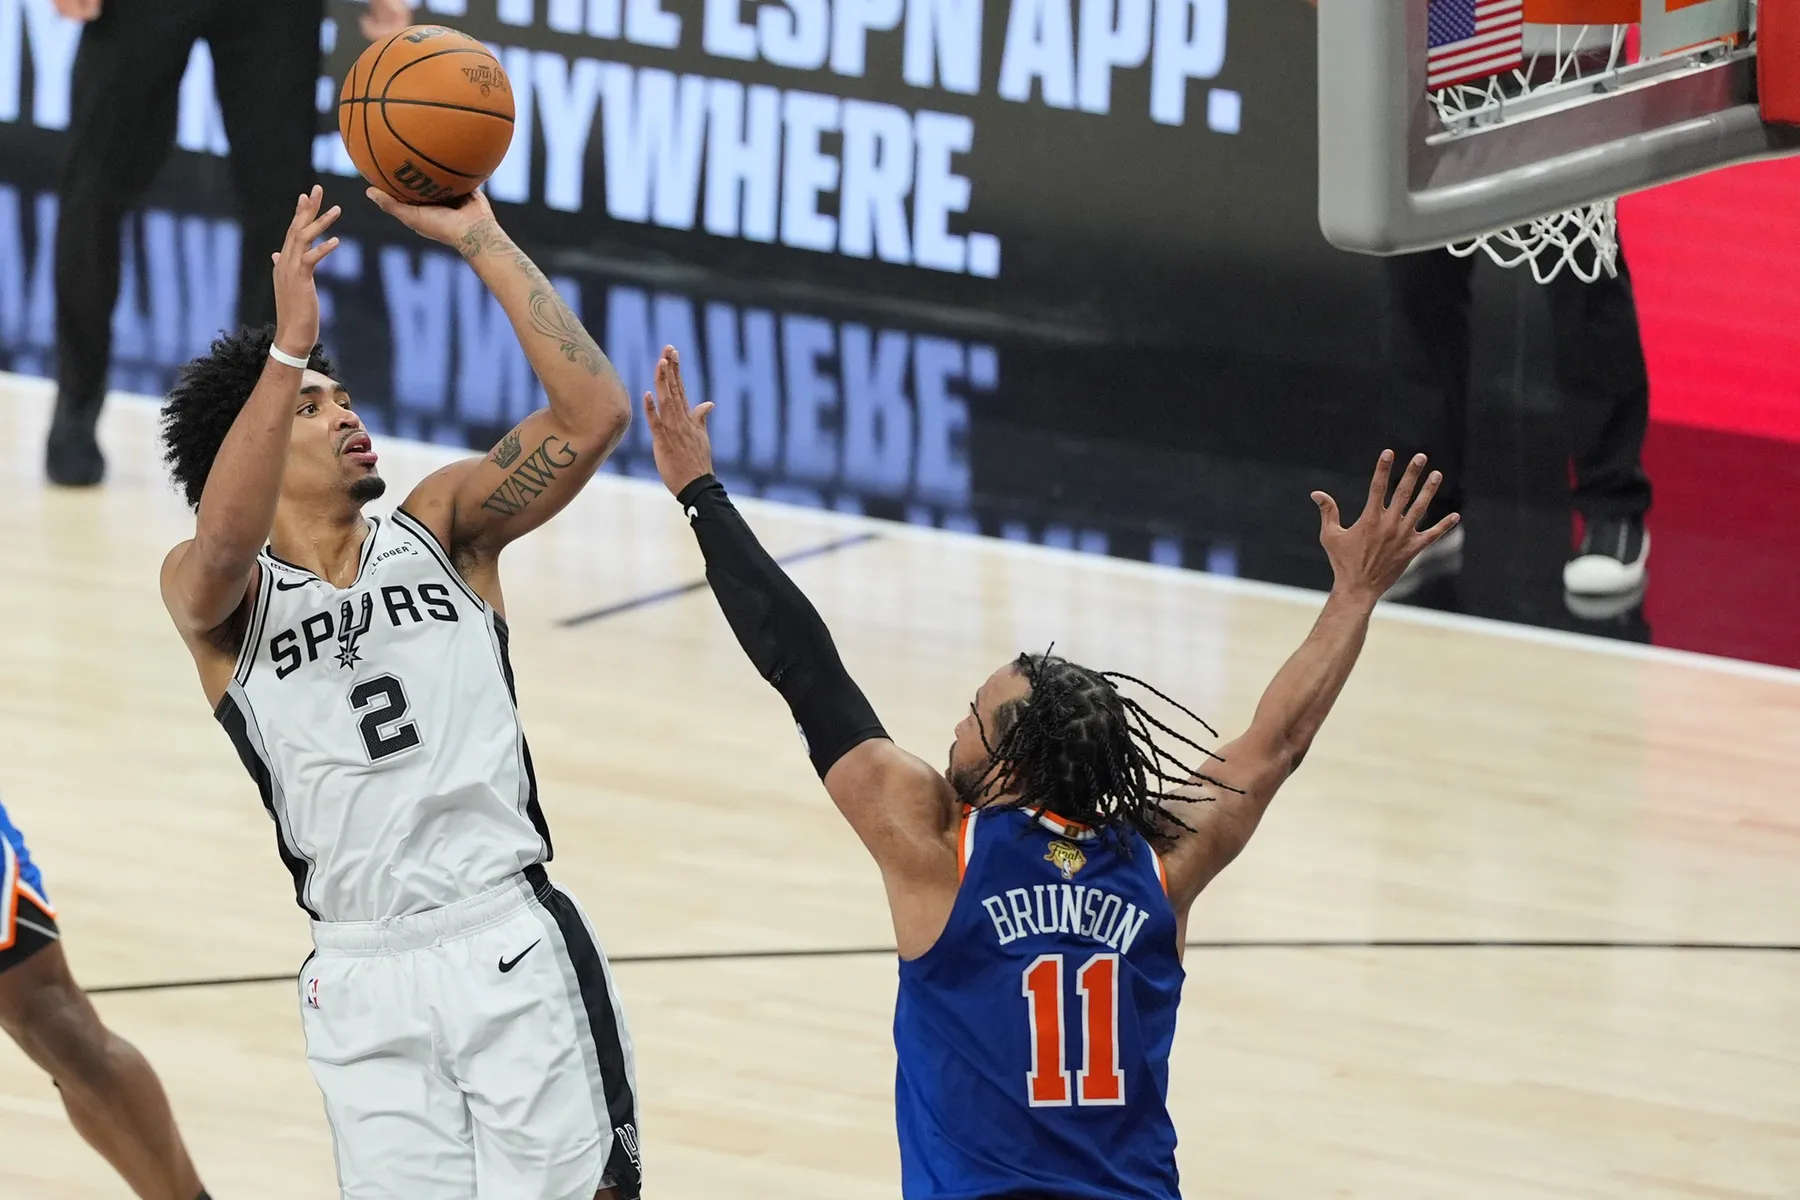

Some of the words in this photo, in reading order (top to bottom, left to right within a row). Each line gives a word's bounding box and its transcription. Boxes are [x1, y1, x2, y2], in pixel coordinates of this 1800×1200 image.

[998, 0, 1242, 134] APP.
[481, 435, 578, 516] WAWG
[372, 545, 410, 567] LEDGER
[269, 583, 459, 681] SPURS
[347, 671, 425, 768] 2
[982, 883, 1150, 956] BRUNSON
[1022, 953, 1126, 1108] 11
